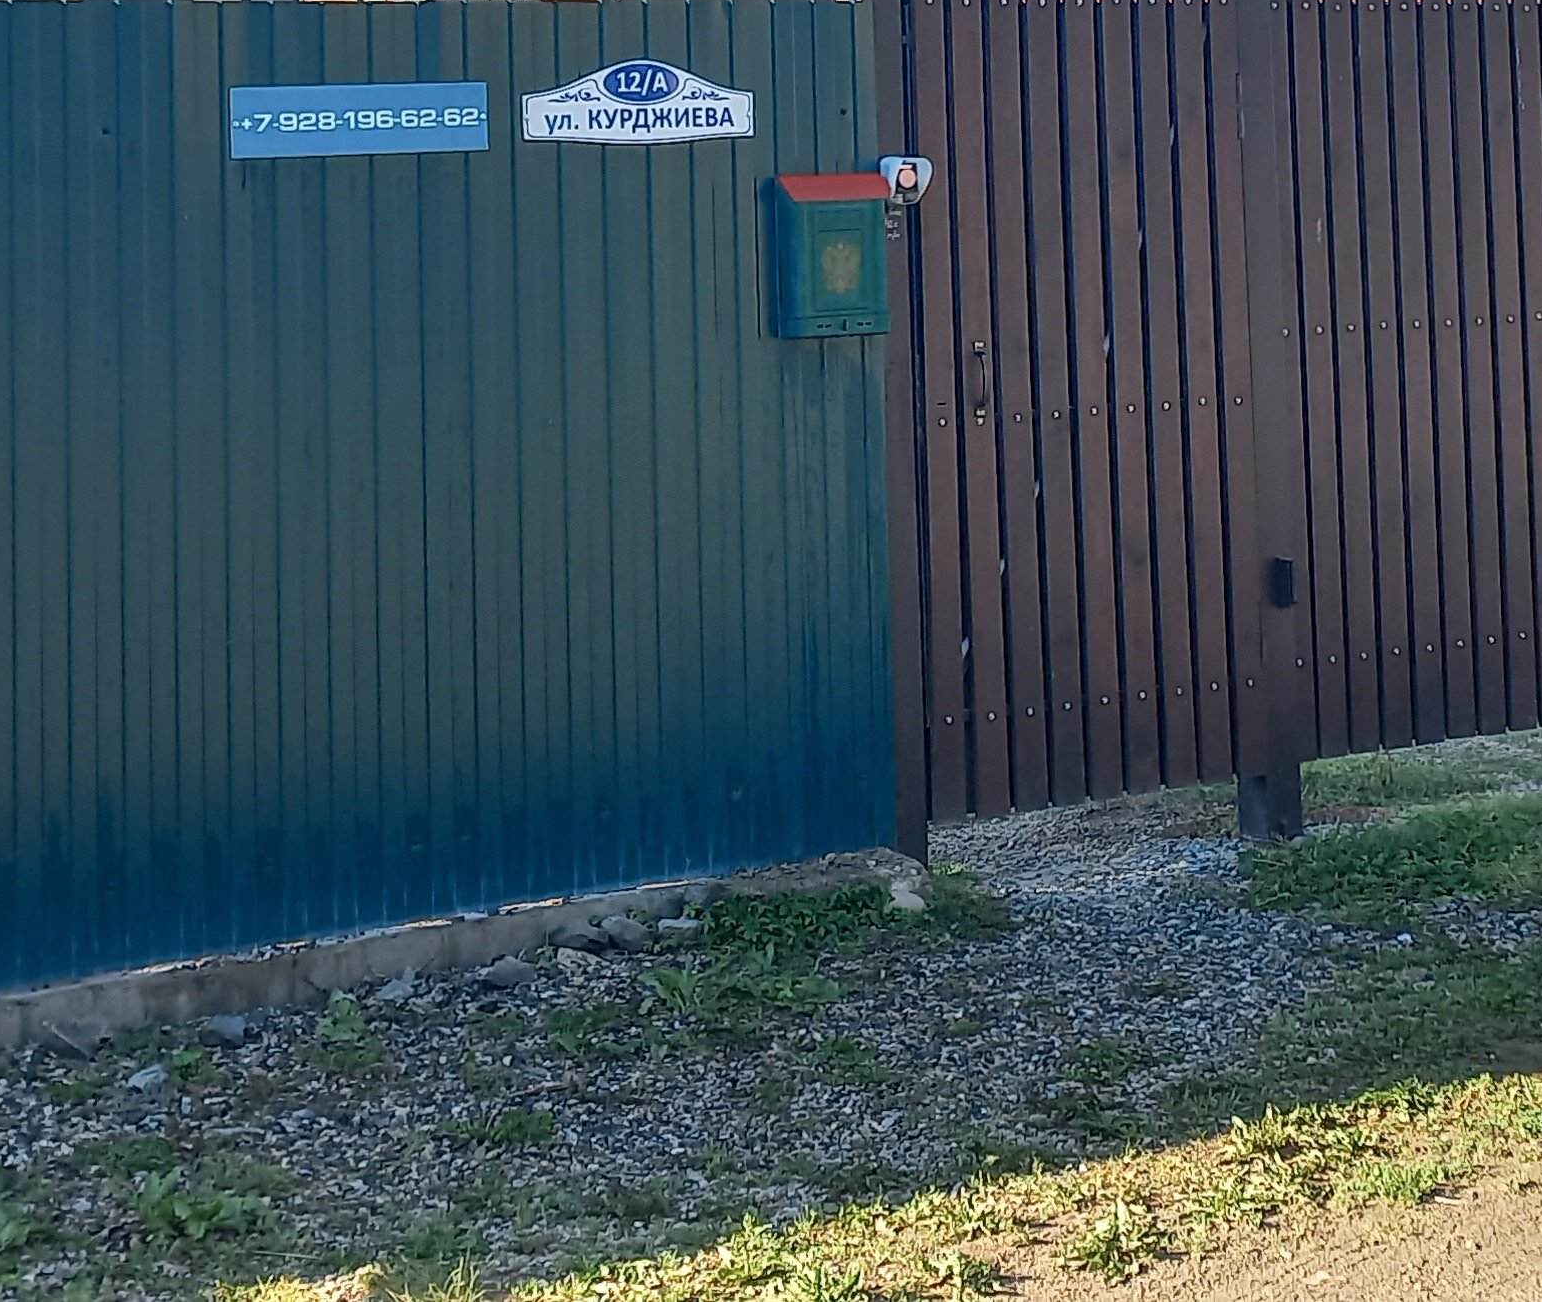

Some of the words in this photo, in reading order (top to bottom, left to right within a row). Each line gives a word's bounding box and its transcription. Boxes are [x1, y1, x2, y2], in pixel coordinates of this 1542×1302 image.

[240, 107, 480, 133] +7-928-196-62-62
[544, 113, 580, 135] ул.
[587, 106, 735, 133] КУРДЖИЕВА
